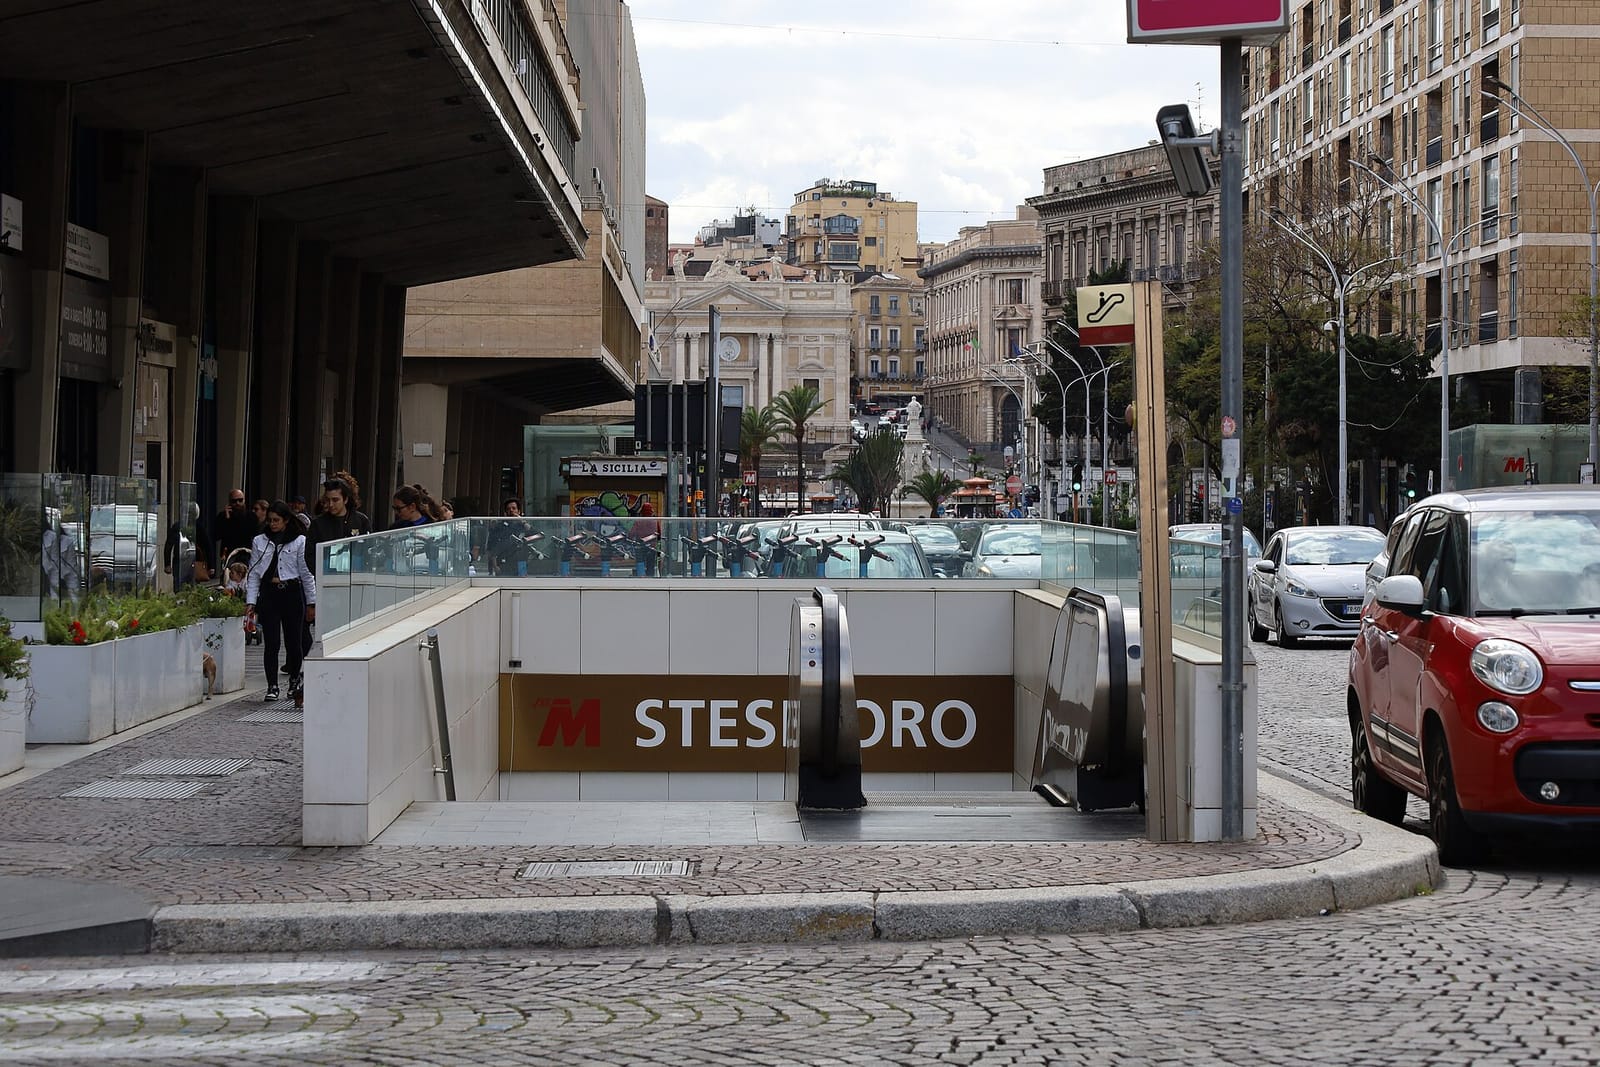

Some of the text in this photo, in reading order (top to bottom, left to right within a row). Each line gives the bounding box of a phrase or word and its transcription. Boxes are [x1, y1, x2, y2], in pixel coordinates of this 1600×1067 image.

[581, 463, 598, 473] LA
[602, 463, 648, 473] SICILIA
[634, 698, 978, 749] STESIORO
